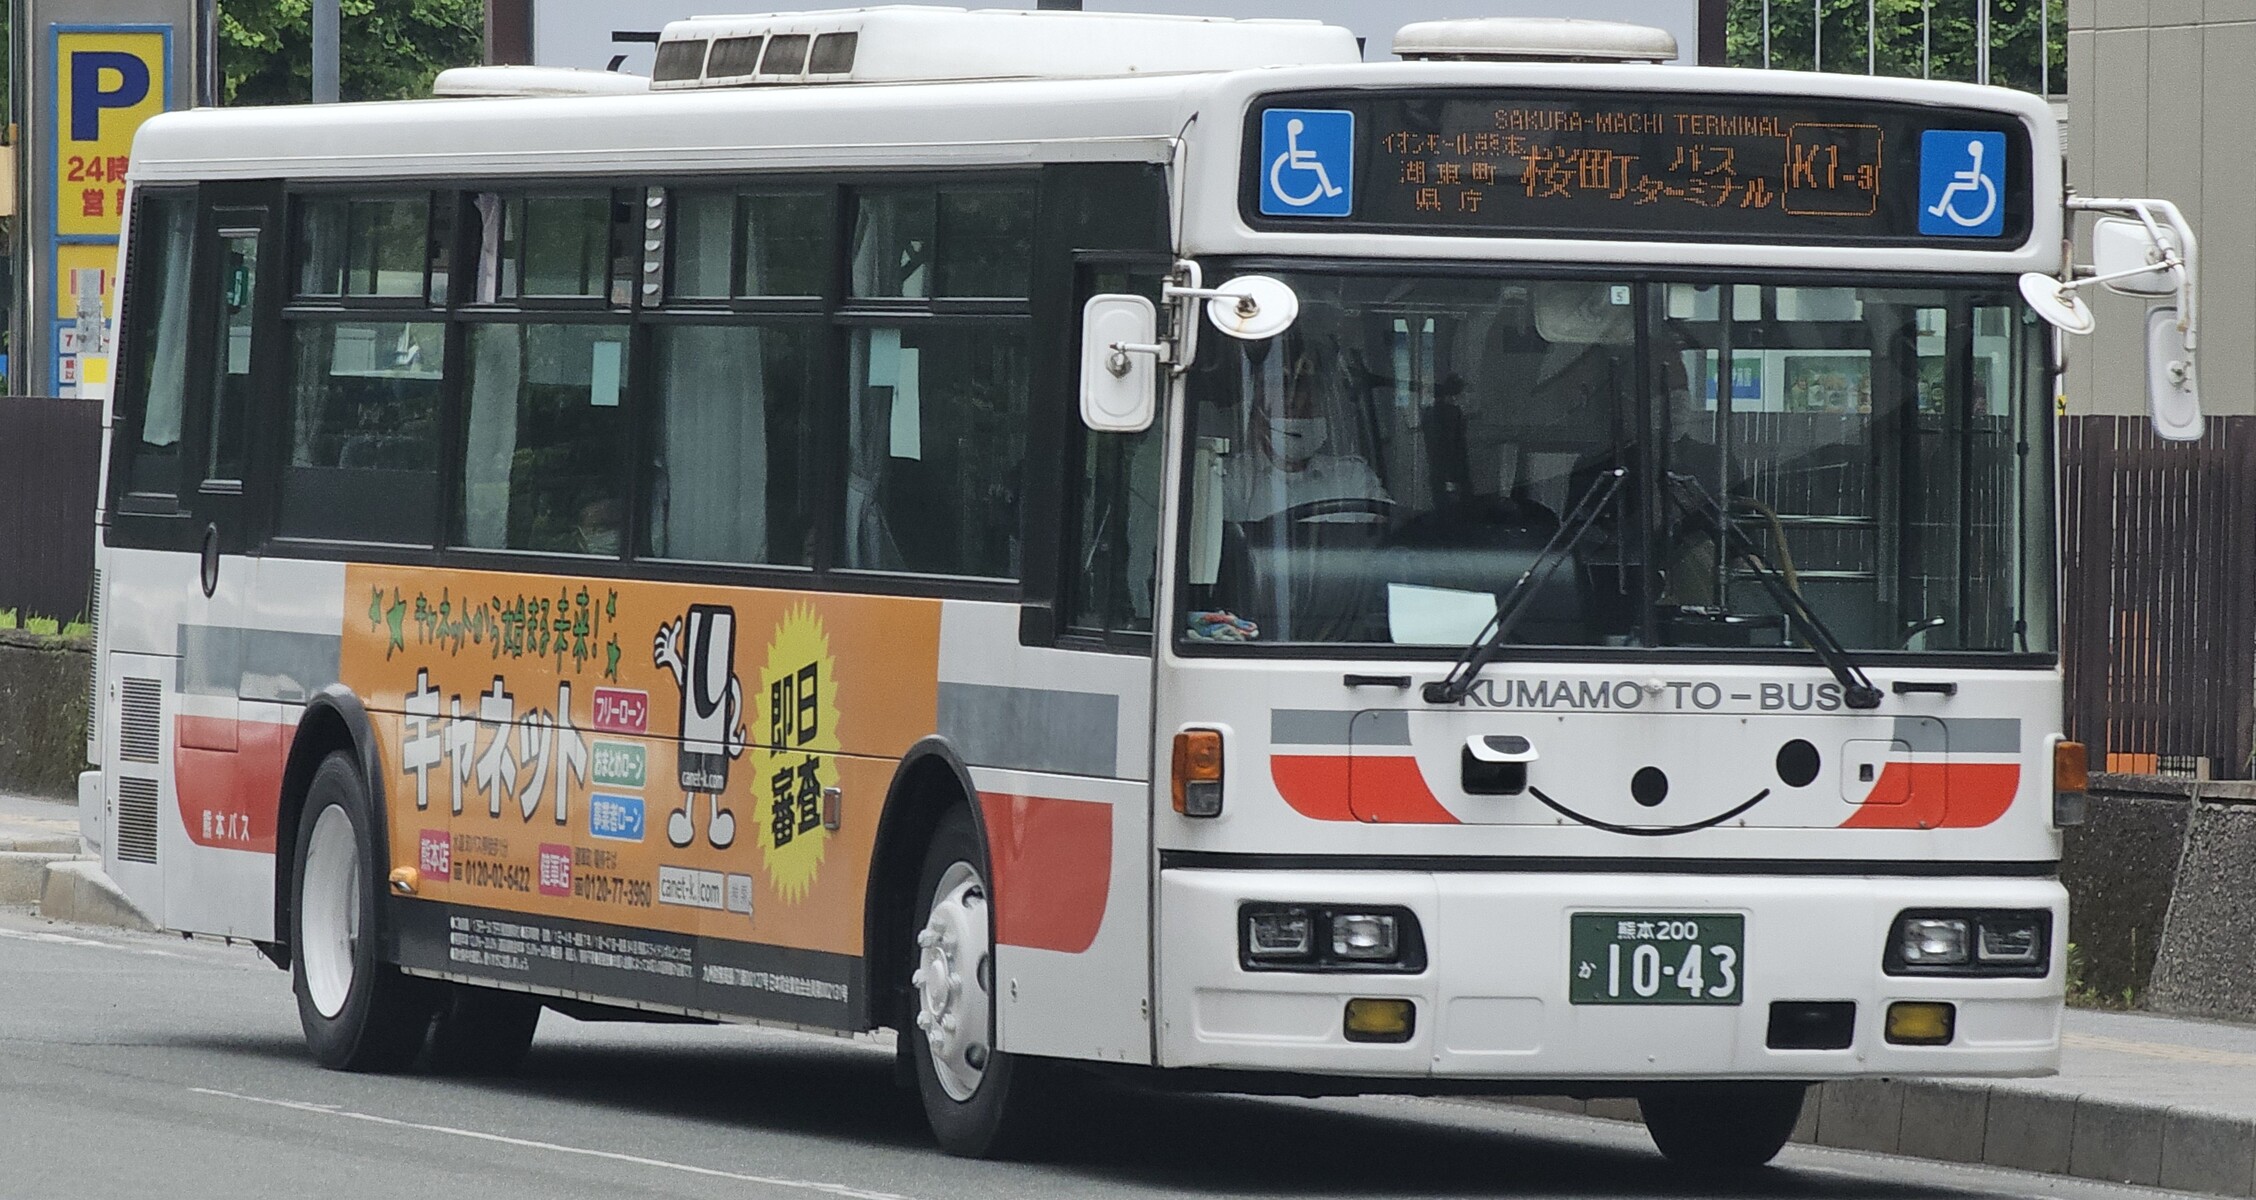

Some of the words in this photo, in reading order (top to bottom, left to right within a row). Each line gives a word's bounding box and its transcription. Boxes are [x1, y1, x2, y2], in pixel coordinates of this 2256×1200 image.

[71, 51, 150, 141] P
[1495, 109, 1664, 134] SAKURA-MACHI
[1674, 113, 1788, 138] TERMINAL
[1400, 159, 1497, 186] 湖東町
[1520, 144, 1640, 200] 桜町
[1669, 143, 1737, 176] バス
[1792, 143, 1873, 190] K1-3
[1415, 187, 1483, 212] 県庁
[1630, 174, 1773, 209] ターミナル
[596, 696, 645, 727] フリーローン
[771, 661, 818, 758] 即日
[403, 667, 588, 826] キャネット
[771, 754, 821, 849] 審査
[203, 807, 249, 841] 熊本バス
[1577, 961, 1597, 979] か
[1608, 944, 1737, 997] 10-43
